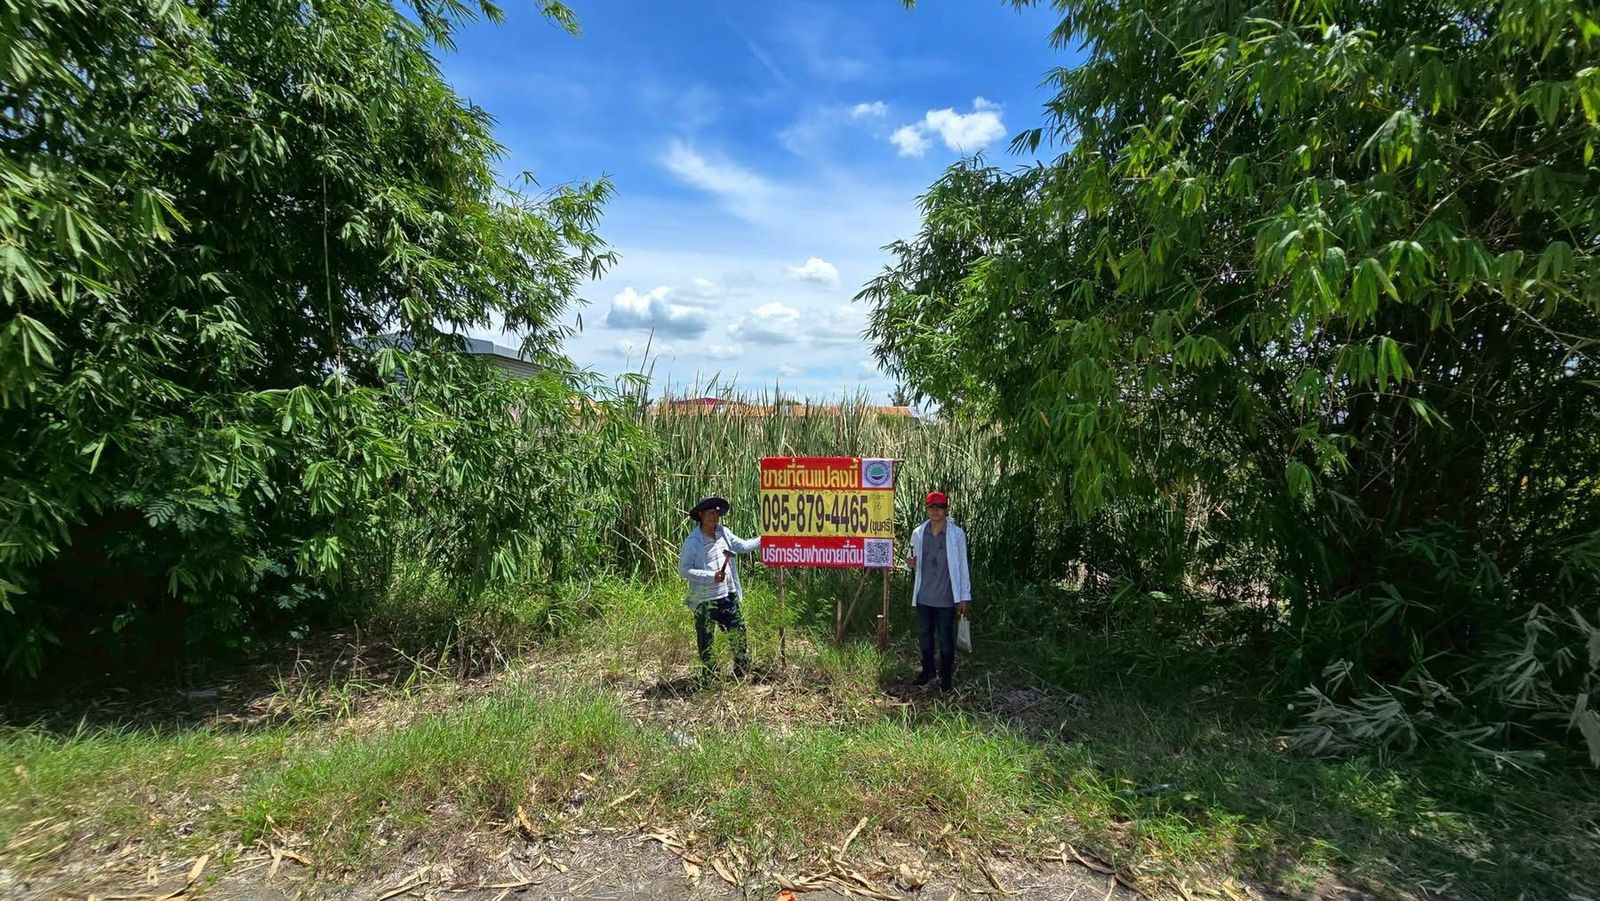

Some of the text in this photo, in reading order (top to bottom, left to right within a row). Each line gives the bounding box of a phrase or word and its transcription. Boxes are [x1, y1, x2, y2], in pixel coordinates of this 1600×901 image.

[763, 458, 858, 488] ขายที่ดินแปลงนี้
[762, 494, 869, 533] 095-879-4465
[762, 540, 864, 564] บริการรับฝากขายที่ดิน
